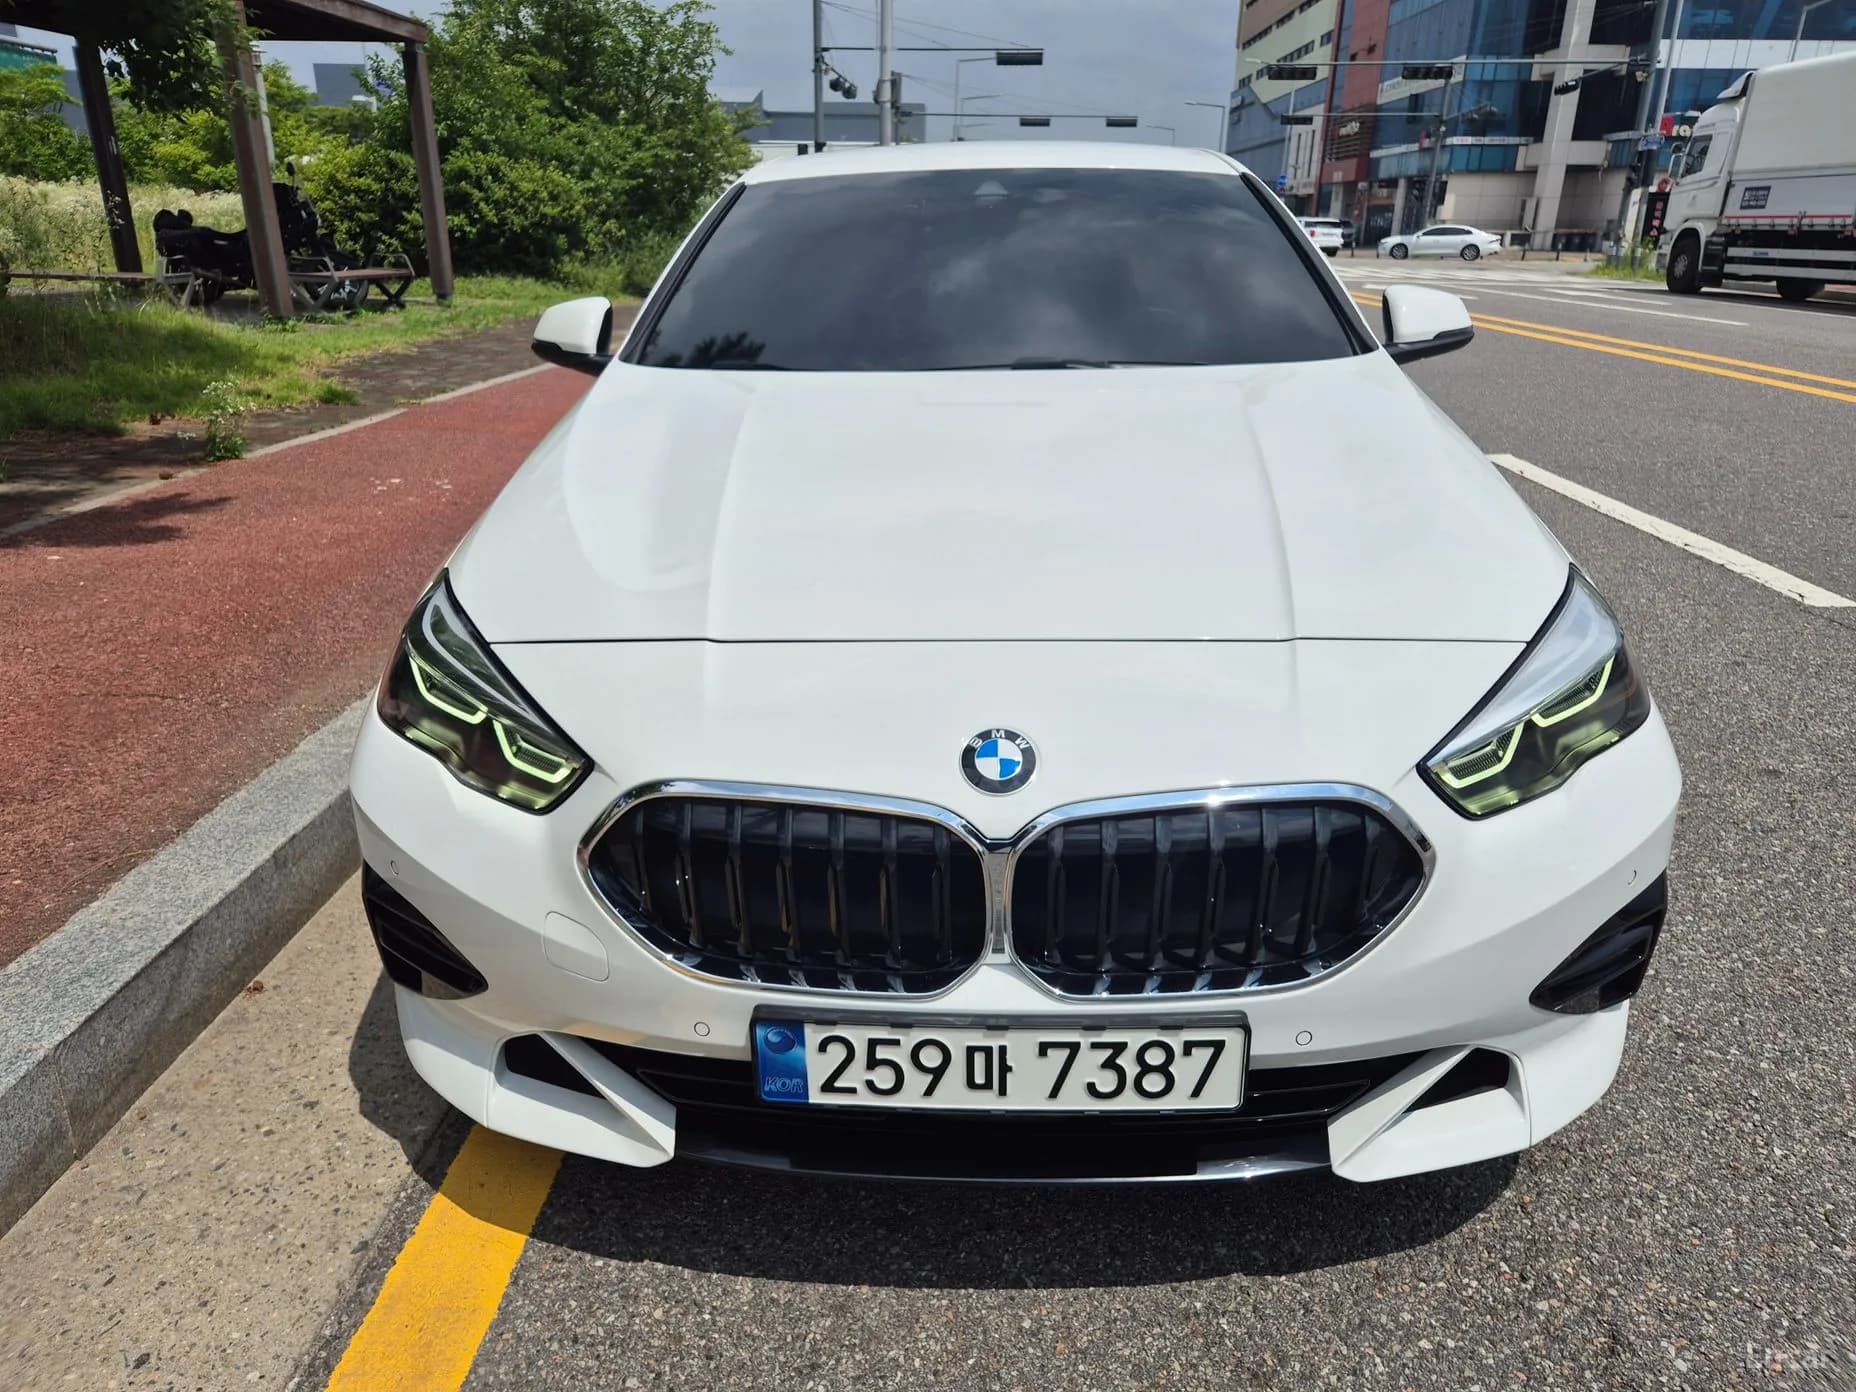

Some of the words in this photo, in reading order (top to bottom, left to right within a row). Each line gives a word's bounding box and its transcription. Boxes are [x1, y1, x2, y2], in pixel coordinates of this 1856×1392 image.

[969, 729, 1031, 749] BMW
[1037, 1039, 1227, 1100] 7387
[764, 1077, 804, 1093] KOR
